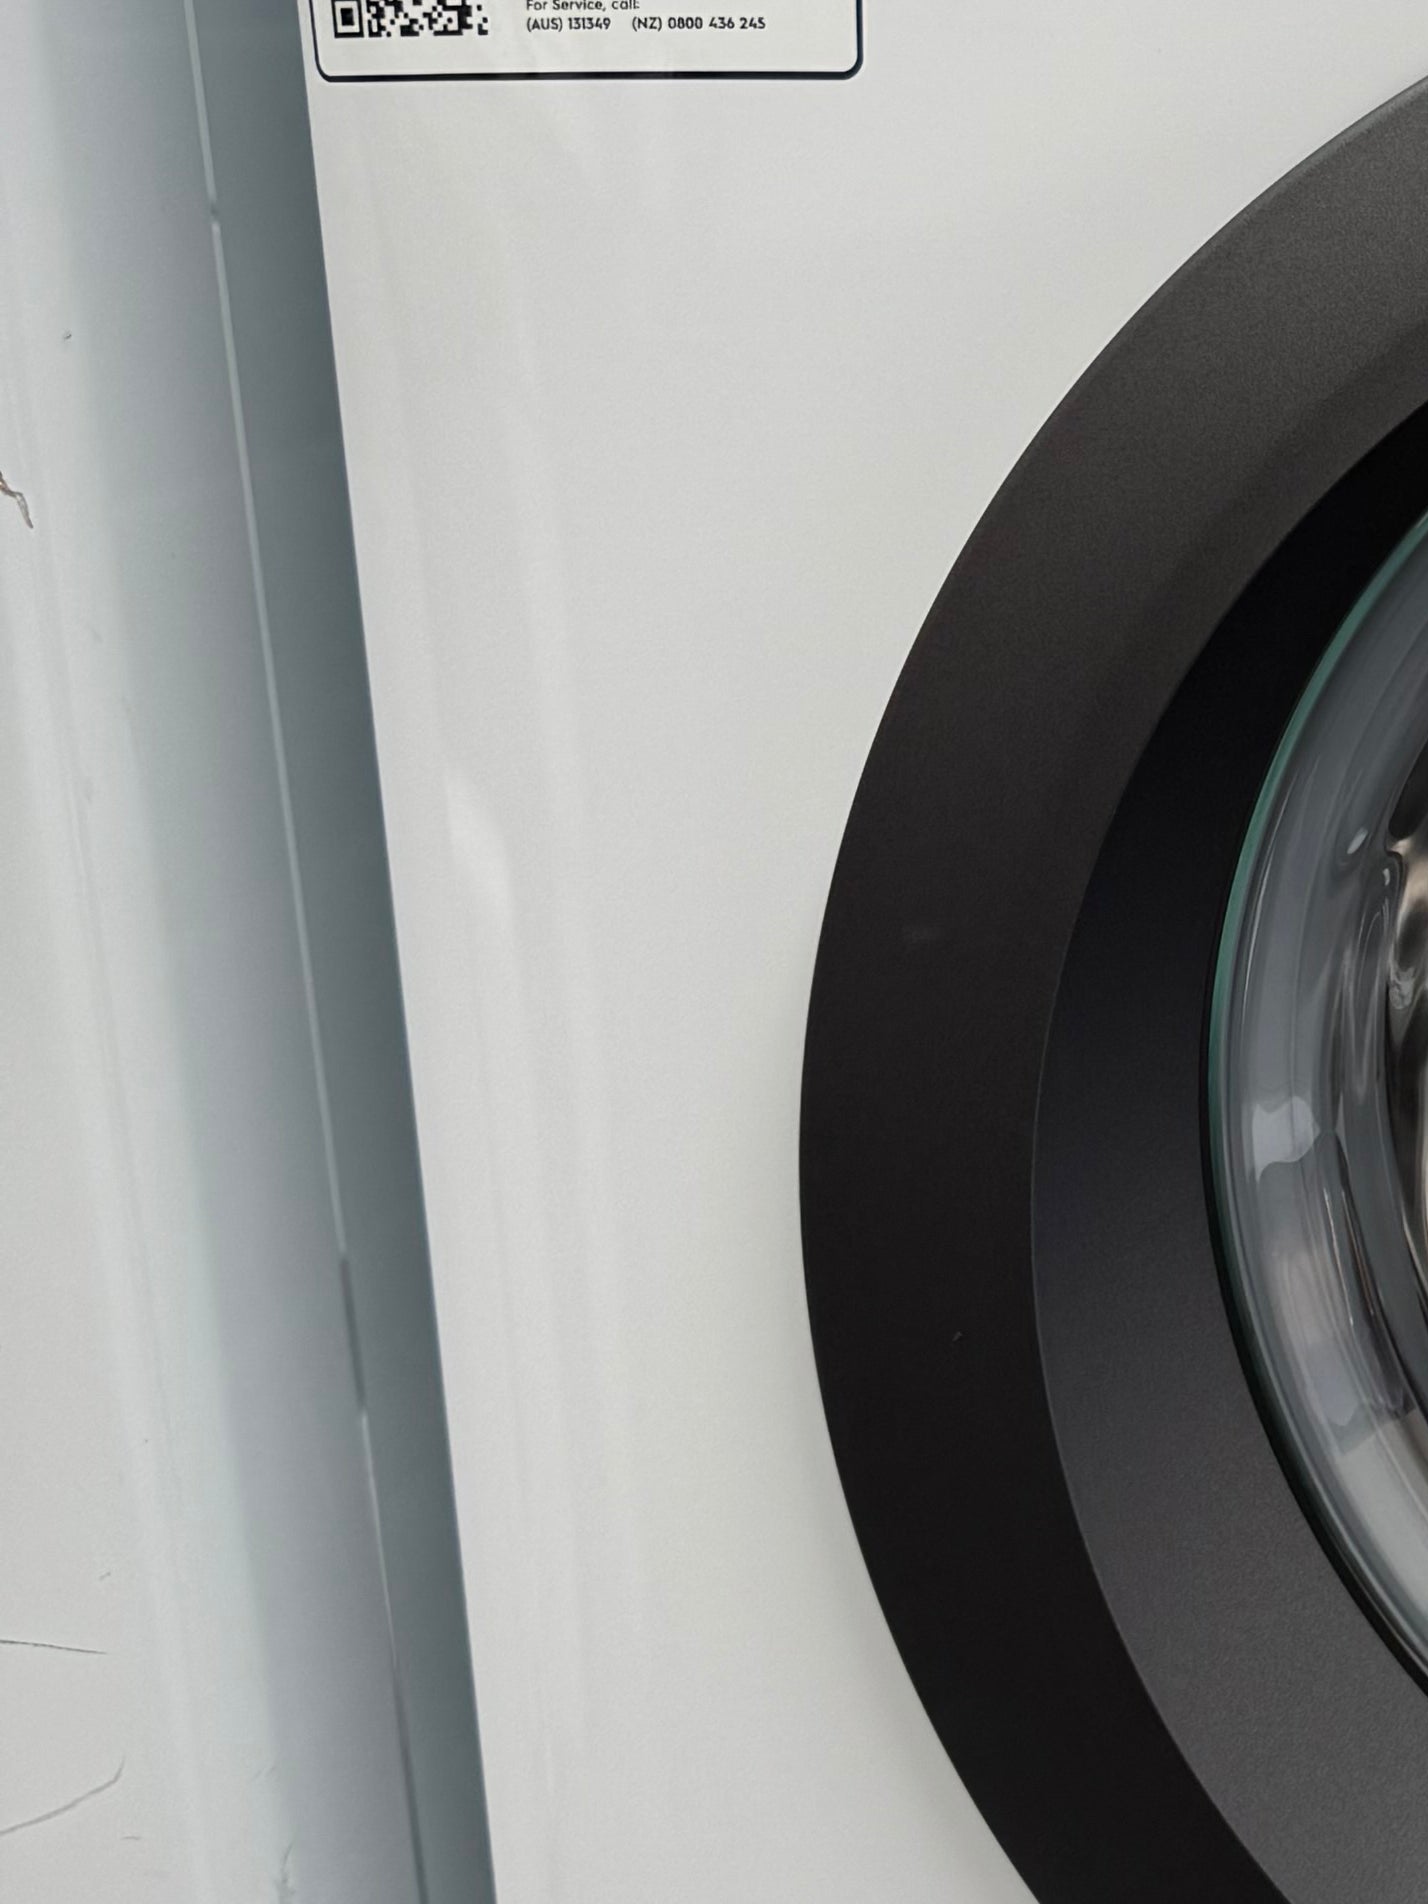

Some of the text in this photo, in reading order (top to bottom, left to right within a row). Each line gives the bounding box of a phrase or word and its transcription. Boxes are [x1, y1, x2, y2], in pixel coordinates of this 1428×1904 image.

[526, 0, 640, 12] For Service, call:
[526, 16, 766, 32] (AUS) 131349 (NZ) 0800 436 245
